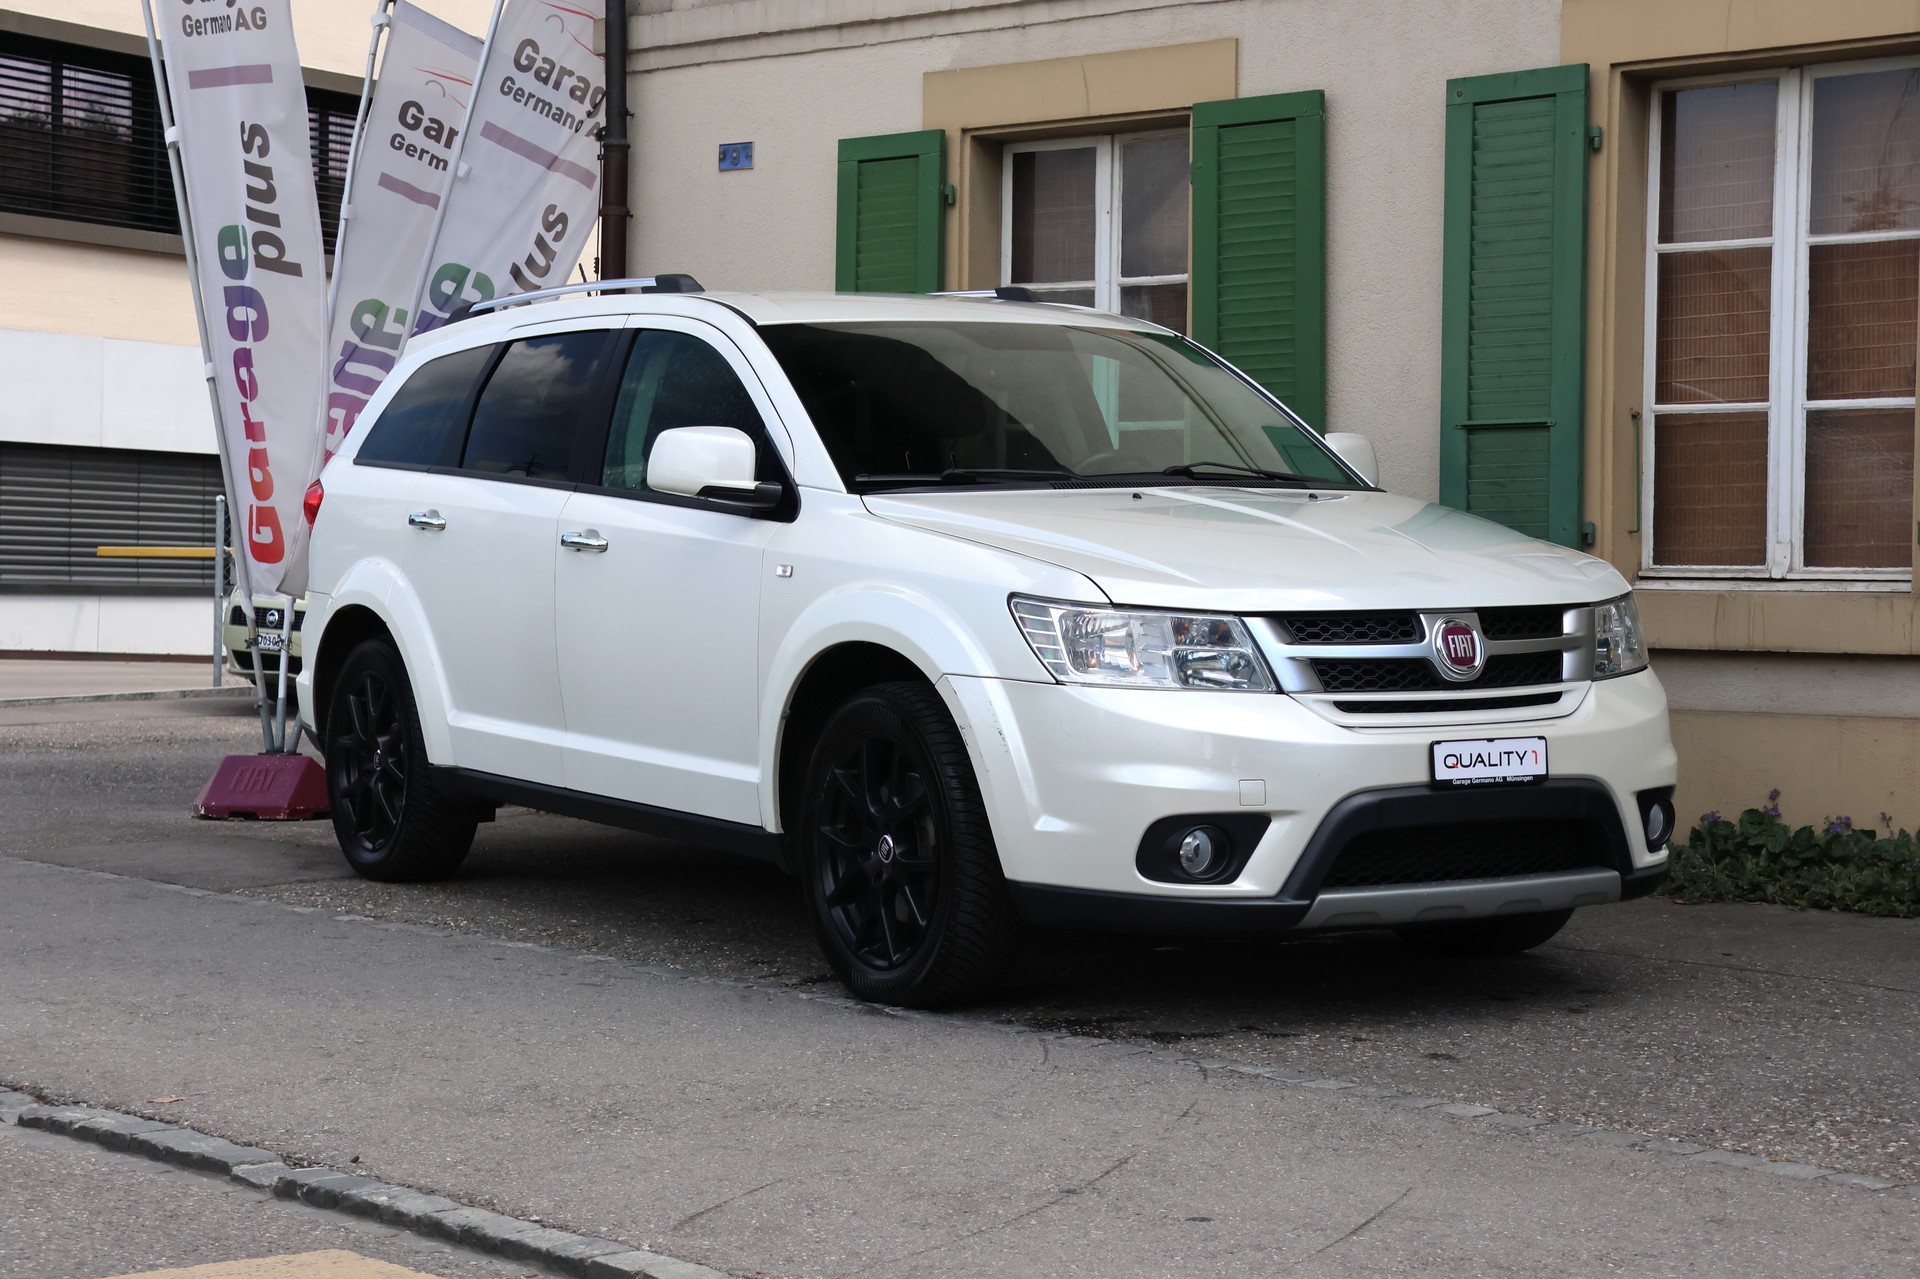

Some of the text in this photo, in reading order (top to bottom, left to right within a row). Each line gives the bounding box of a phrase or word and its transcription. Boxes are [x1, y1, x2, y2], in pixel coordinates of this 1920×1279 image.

[235, 7, 267, 31] AG
[513, 38, 606, 119] Garag
[398, 100, 459, 150] Gar
[500, 75, 584, 133] Germano
[390, 133, 449, 172] Germ
[240, 121, 303, 278] plus
[217, 224, 285, 565] Garage
[1447, 634, 1474, 658] FIAT
[1443, 750, 1528, 769] QUALITY
